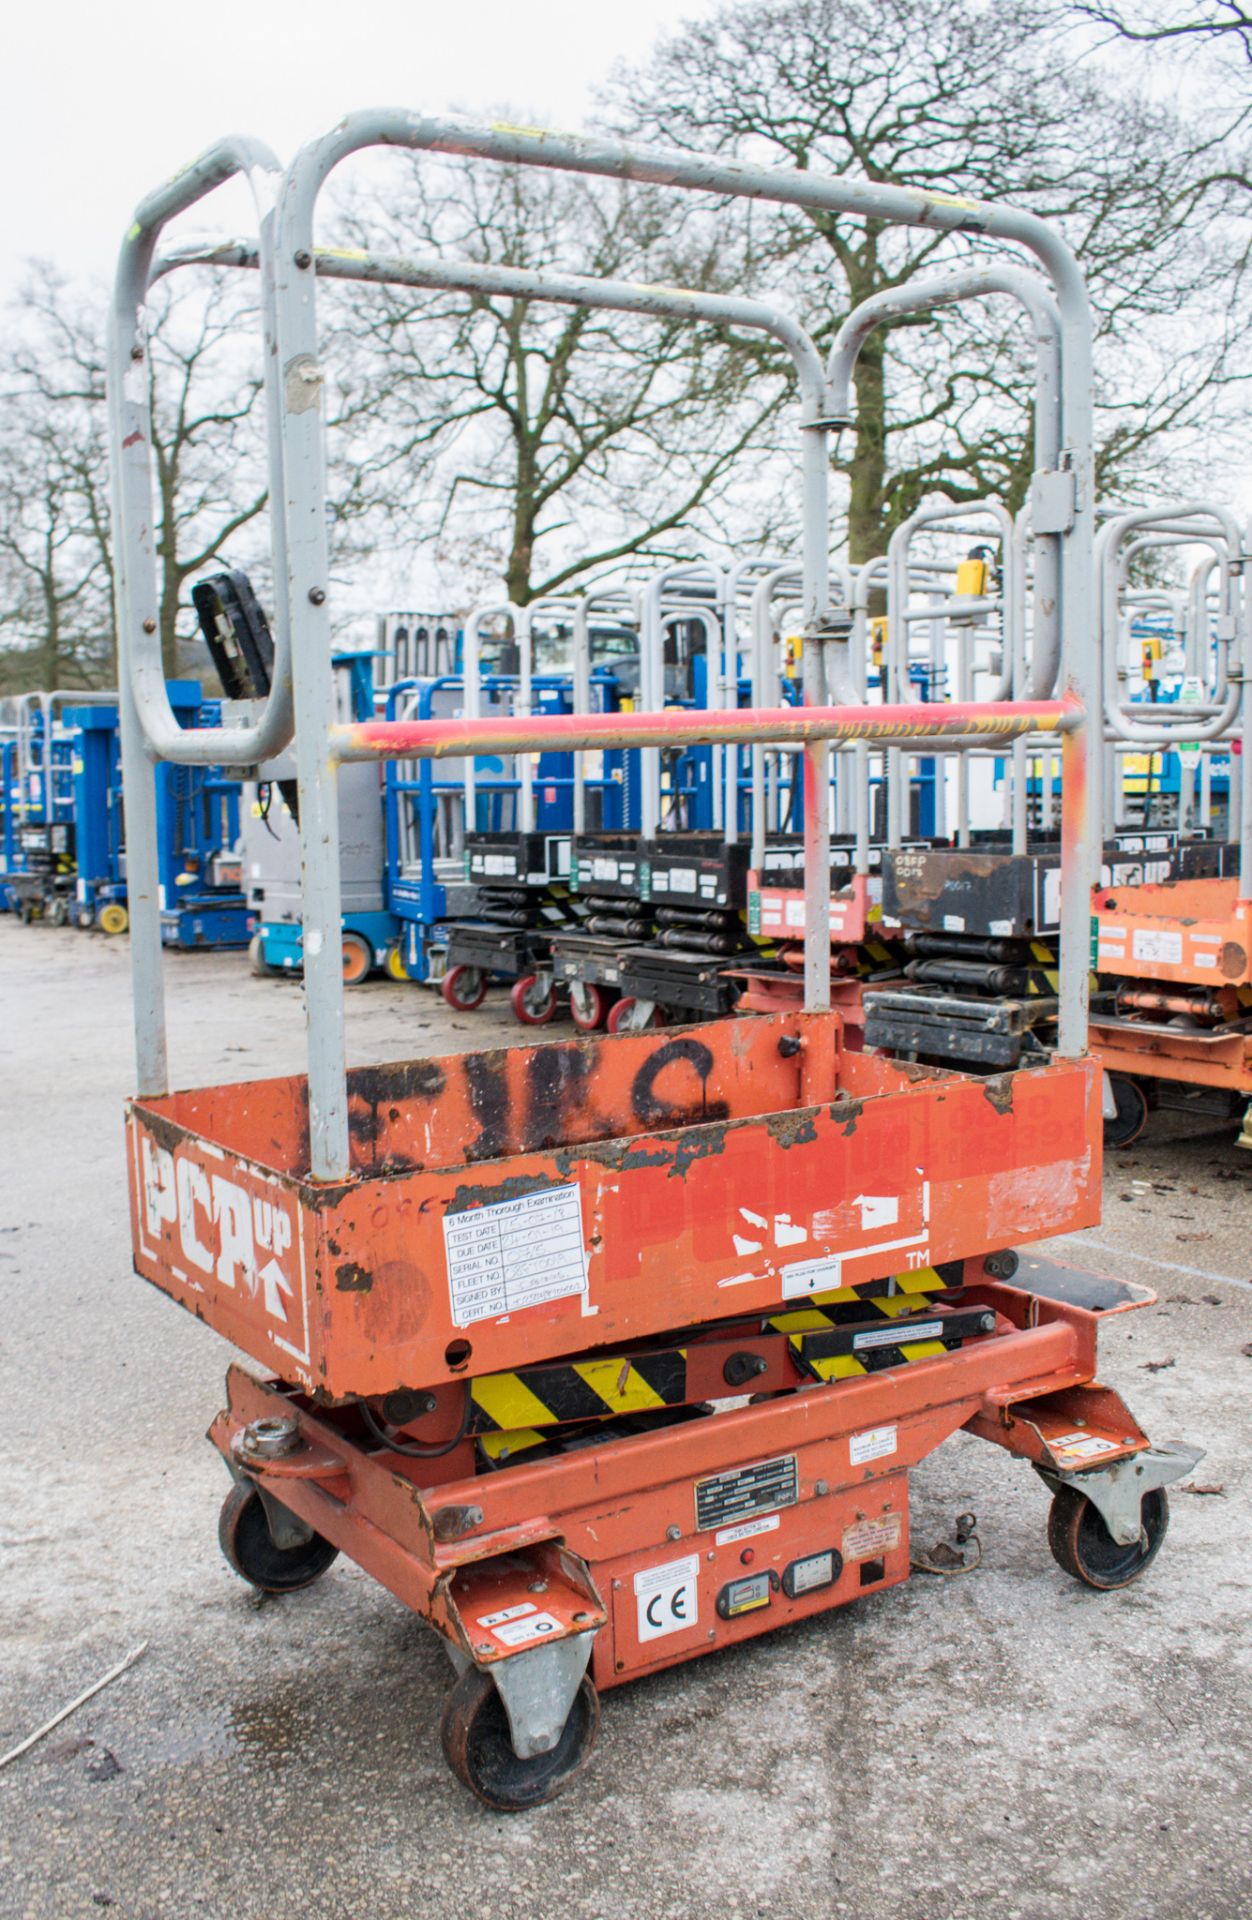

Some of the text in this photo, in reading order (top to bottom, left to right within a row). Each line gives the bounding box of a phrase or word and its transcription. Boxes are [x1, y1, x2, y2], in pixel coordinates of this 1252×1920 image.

[448, 1191, 575, 1227] 6 Month Thorough Examination
[254, 1196, 292, 1258] UP
[452, 1230, 473, 1243] TEST
[476, 1225, 497, 1238] DATE
[457, 1247, 475, 1258] DUE
[478, 1241, 499, 1253] DATE
[453, 1261, 482, 1274] SERIAL
[905, 1248, 930, 1270] TM
[457, 1275, 485, 1288] FLEET
[456, 1291, 488, 1304] SIGNED
[490, 1286, 502, 1297] BY
[462, 1306, 486, 1319] CERT.
[647, 1586, 686, 1628] CE
